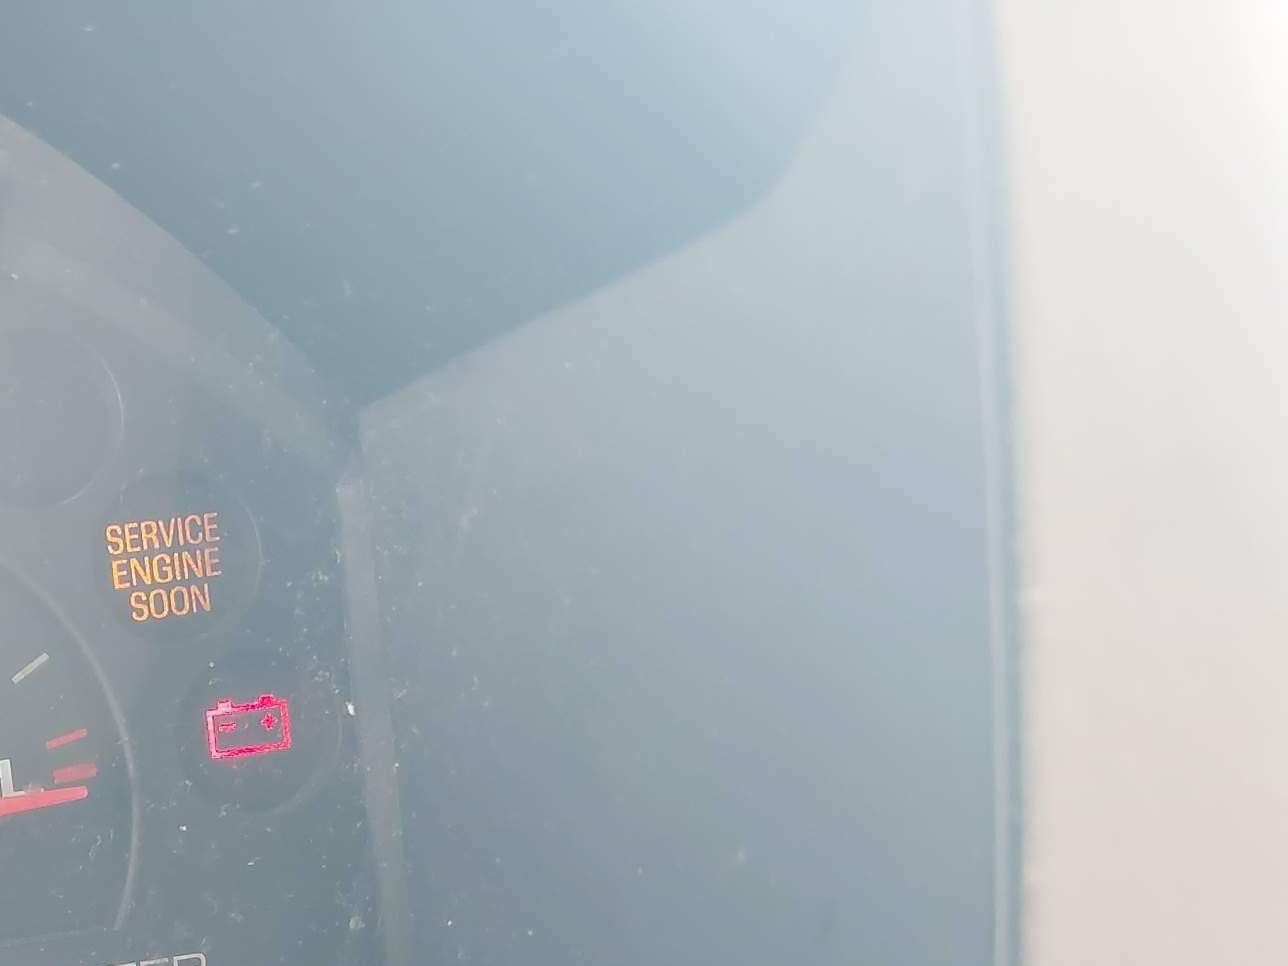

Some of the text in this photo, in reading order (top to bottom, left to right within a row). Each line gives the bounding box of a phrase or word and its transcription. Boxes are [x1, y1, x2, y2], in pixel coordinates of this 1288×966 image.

[106, 513, 220, 556] SERVICE
[112, 547, 222, 590] ENGINE
[128, 584, 212, 622] SOON
